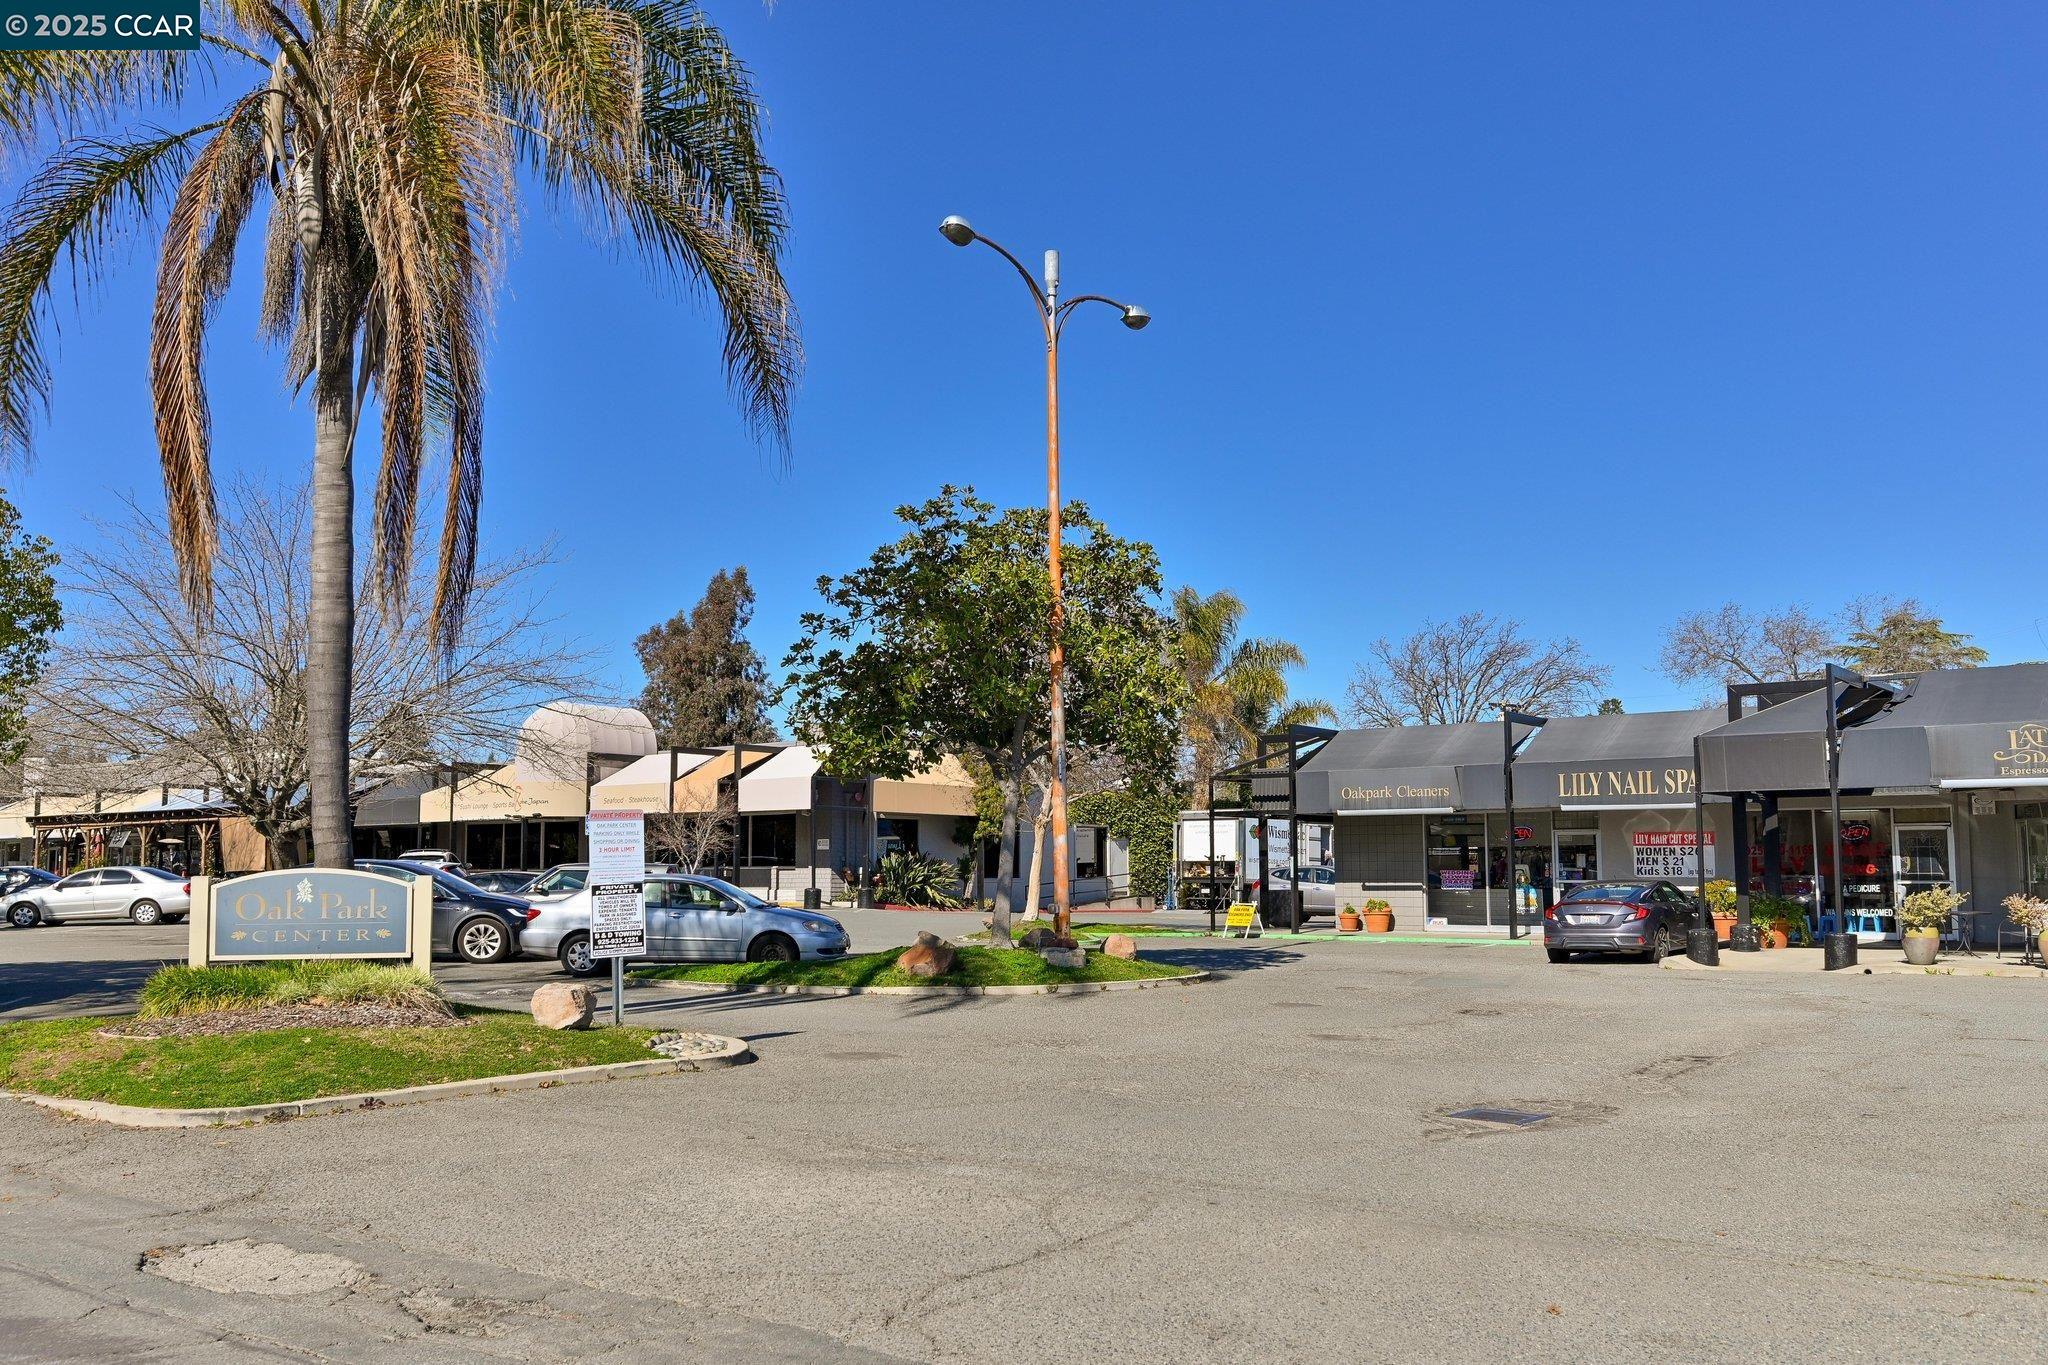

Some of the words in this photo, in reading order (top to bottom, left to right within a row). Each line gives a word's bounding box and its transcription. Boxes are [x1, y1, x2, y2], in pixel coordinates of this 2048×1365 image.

[2001, 766, 2048, 777] Espresso
[1558, 772, 1603, 798] LILY
[1607, 769, 1660, 796] NAIL
[1664, 768, 1697, 794] SPA
[1341, 785, 1392, 803] Oakpark
[1397, 784, 1450, 799] Cleaners
[615, 811, 643, 819] PROPERTY
[1840, 827, 1870, 838] OPEN
[1635, 834, 1649, 845] LILY
[1650, 834, 1668, 845] HAIR
[1669, 833, 1682, 845] CUT
[1683, 833, 1713, 844] SPEAL
[1635, 847, 1676, 856] WOMEN
[1636, 857, 1659, 866] MEN
[1662, 856, 1670, 866] $
[1673, 857, 1684, 866] 21
[1636, 866, 1660, 876] Kids
[1663, 866, 1683, 876] $18
[595, 888, 639, 896] PROPERTY
[1849, 884, 1881, 893] PEDICURE
[235, 888, 305, 921] Oak
[319, 887, 388, 920] Park
[1857, 908, 1894, 917] WELCOMED
[252, 928, 371, 943] CENTER
